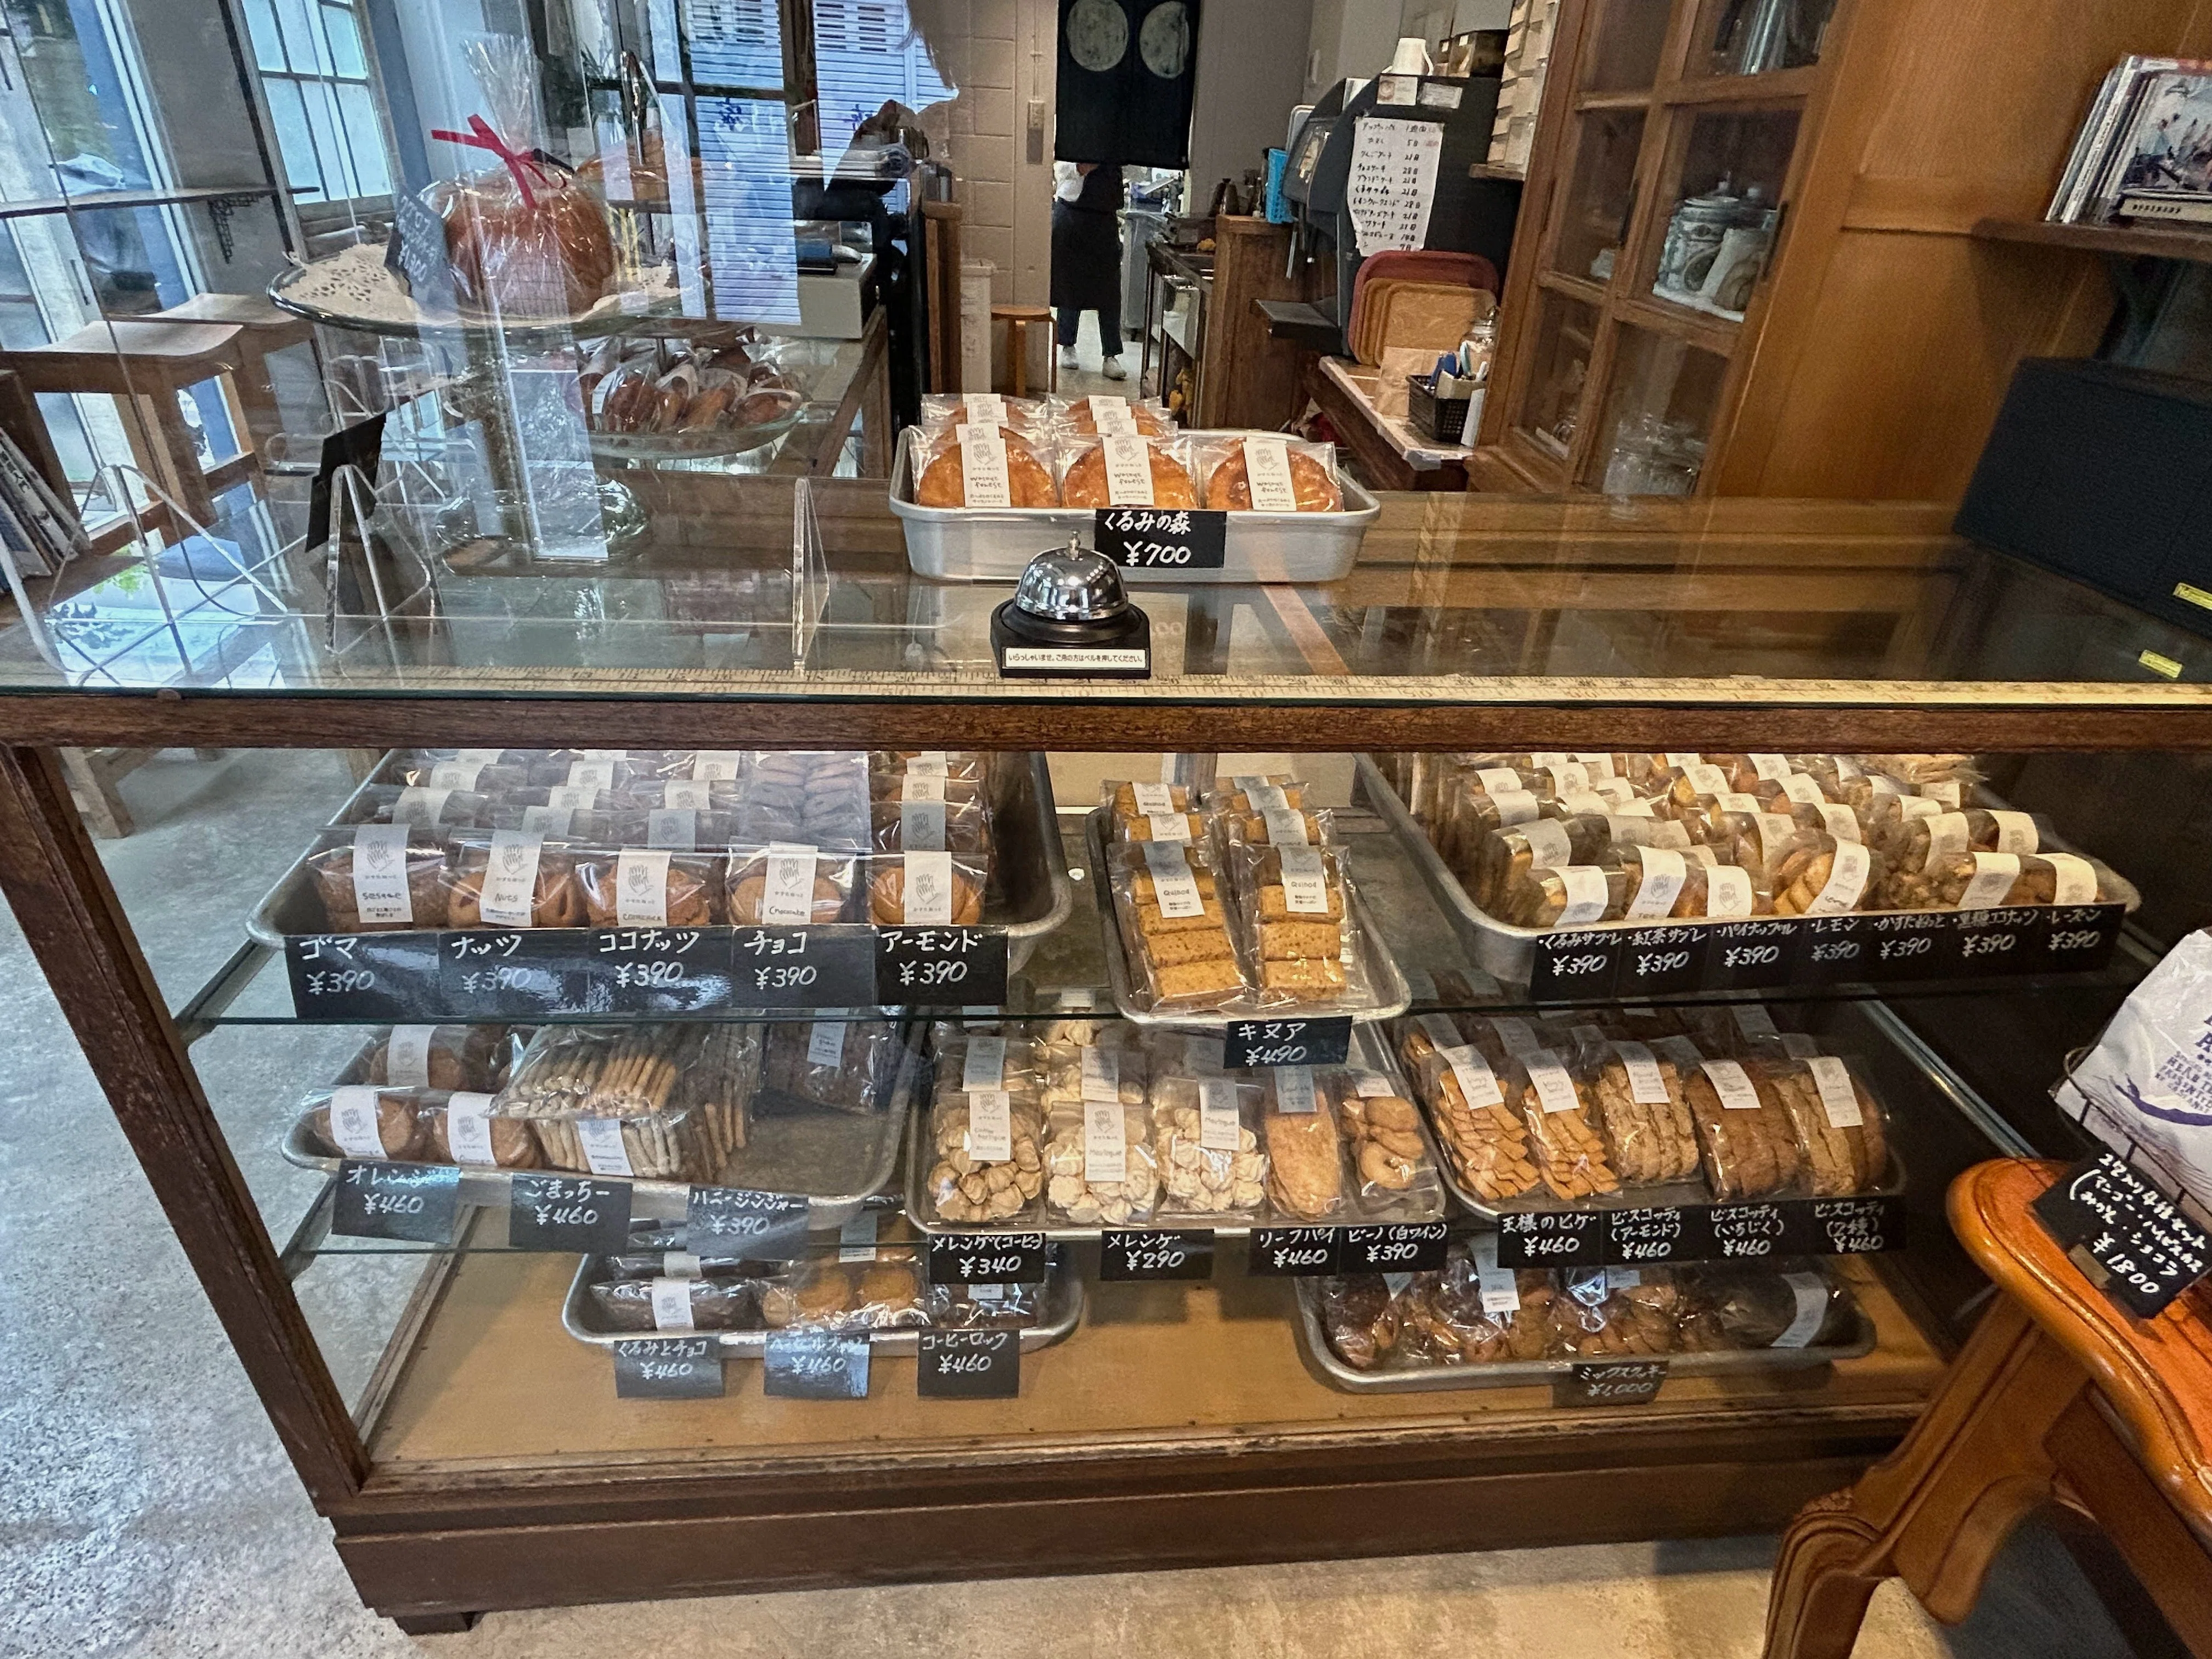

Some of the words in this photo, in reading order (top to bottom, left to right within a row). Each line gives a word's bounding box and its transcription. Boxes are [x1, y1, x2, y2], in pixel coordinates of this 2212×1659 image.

[1104, 510, 1192, 535] くるみの森
[1123, 541, 1192, 567] ¥700
[299, 936, 358, 960] ゴマ
[450, 934, 522, 960] ナッツ
[599, 930, 700, 954] ココナッツ
[743, 930, 807, 956] チョコ
[879, 930, 984, 954] アーモンド
[1811, 940, 1861, 962] ¥390
[1880, 937, 1932, 960] ¥390
[1962, 933, 2017, 958] ¥390
[2048, 930, 2101, 952] ¥390
[1553, 954, 1607, 977] ¥390
[1637, 951, 1690, 976] ¥390
[1724, 945, 1780, 968] ¥390
[307, 969, 376, 995] ¥390
[461, 967, 533, 994] ¥390
[616, 961, 684, 988] ¥390
[754, 966, 817, 990] ¥390
[899, 960, 968, 987] ¥390
[1238, 1022, 1307, 1041] キヌア
[1245, 1044, 1307, 1066] ¥490
[364, 1193, 425, 1215] ¥460
[692, 1190, 804, 1211] ハニージンジャー
[1814, 1200, 1886, 1218] ビスコッティ
[534, 1204, 599, 1226] ¥460
[1502, 1212, 1597, 1234] 王様のヒゲ
[1611, 1206, 1681, 1226] ビスコッティ
[1710, 1204, 1779, 1222] ビスコッティ
[710, 1214, 769, 1235] ¥390
[1107, 1233, 1181, 1250] メレンゲ
[1259, 1227, 1336, 1249] リーフパイ
[1524, 1235, 1581, 1257] ¥460
[1723, 1238, 1772, 1257] ¥460
[1833, 1235, 1884, 1254] ¥460
[1126, 1250, 1186, 1271] ¥290
[1273, 1248, 1329, 1268] ¥460
[1366, 1243, 1419, 1262] ¥390
[1622, 1242, 1672, 1261] ¥460
[958, 1255, 1022, 1278] ¥340
[618, 1340, 707, 1358] くるみとチョコ
[922, 1332, 1008, 1351] コーヒーロック
[640, 1361, 693, 1380] ¥460
[791, 1355, 847, 1375] ¥460
[938, 1353, 992, 1374] ¥460
